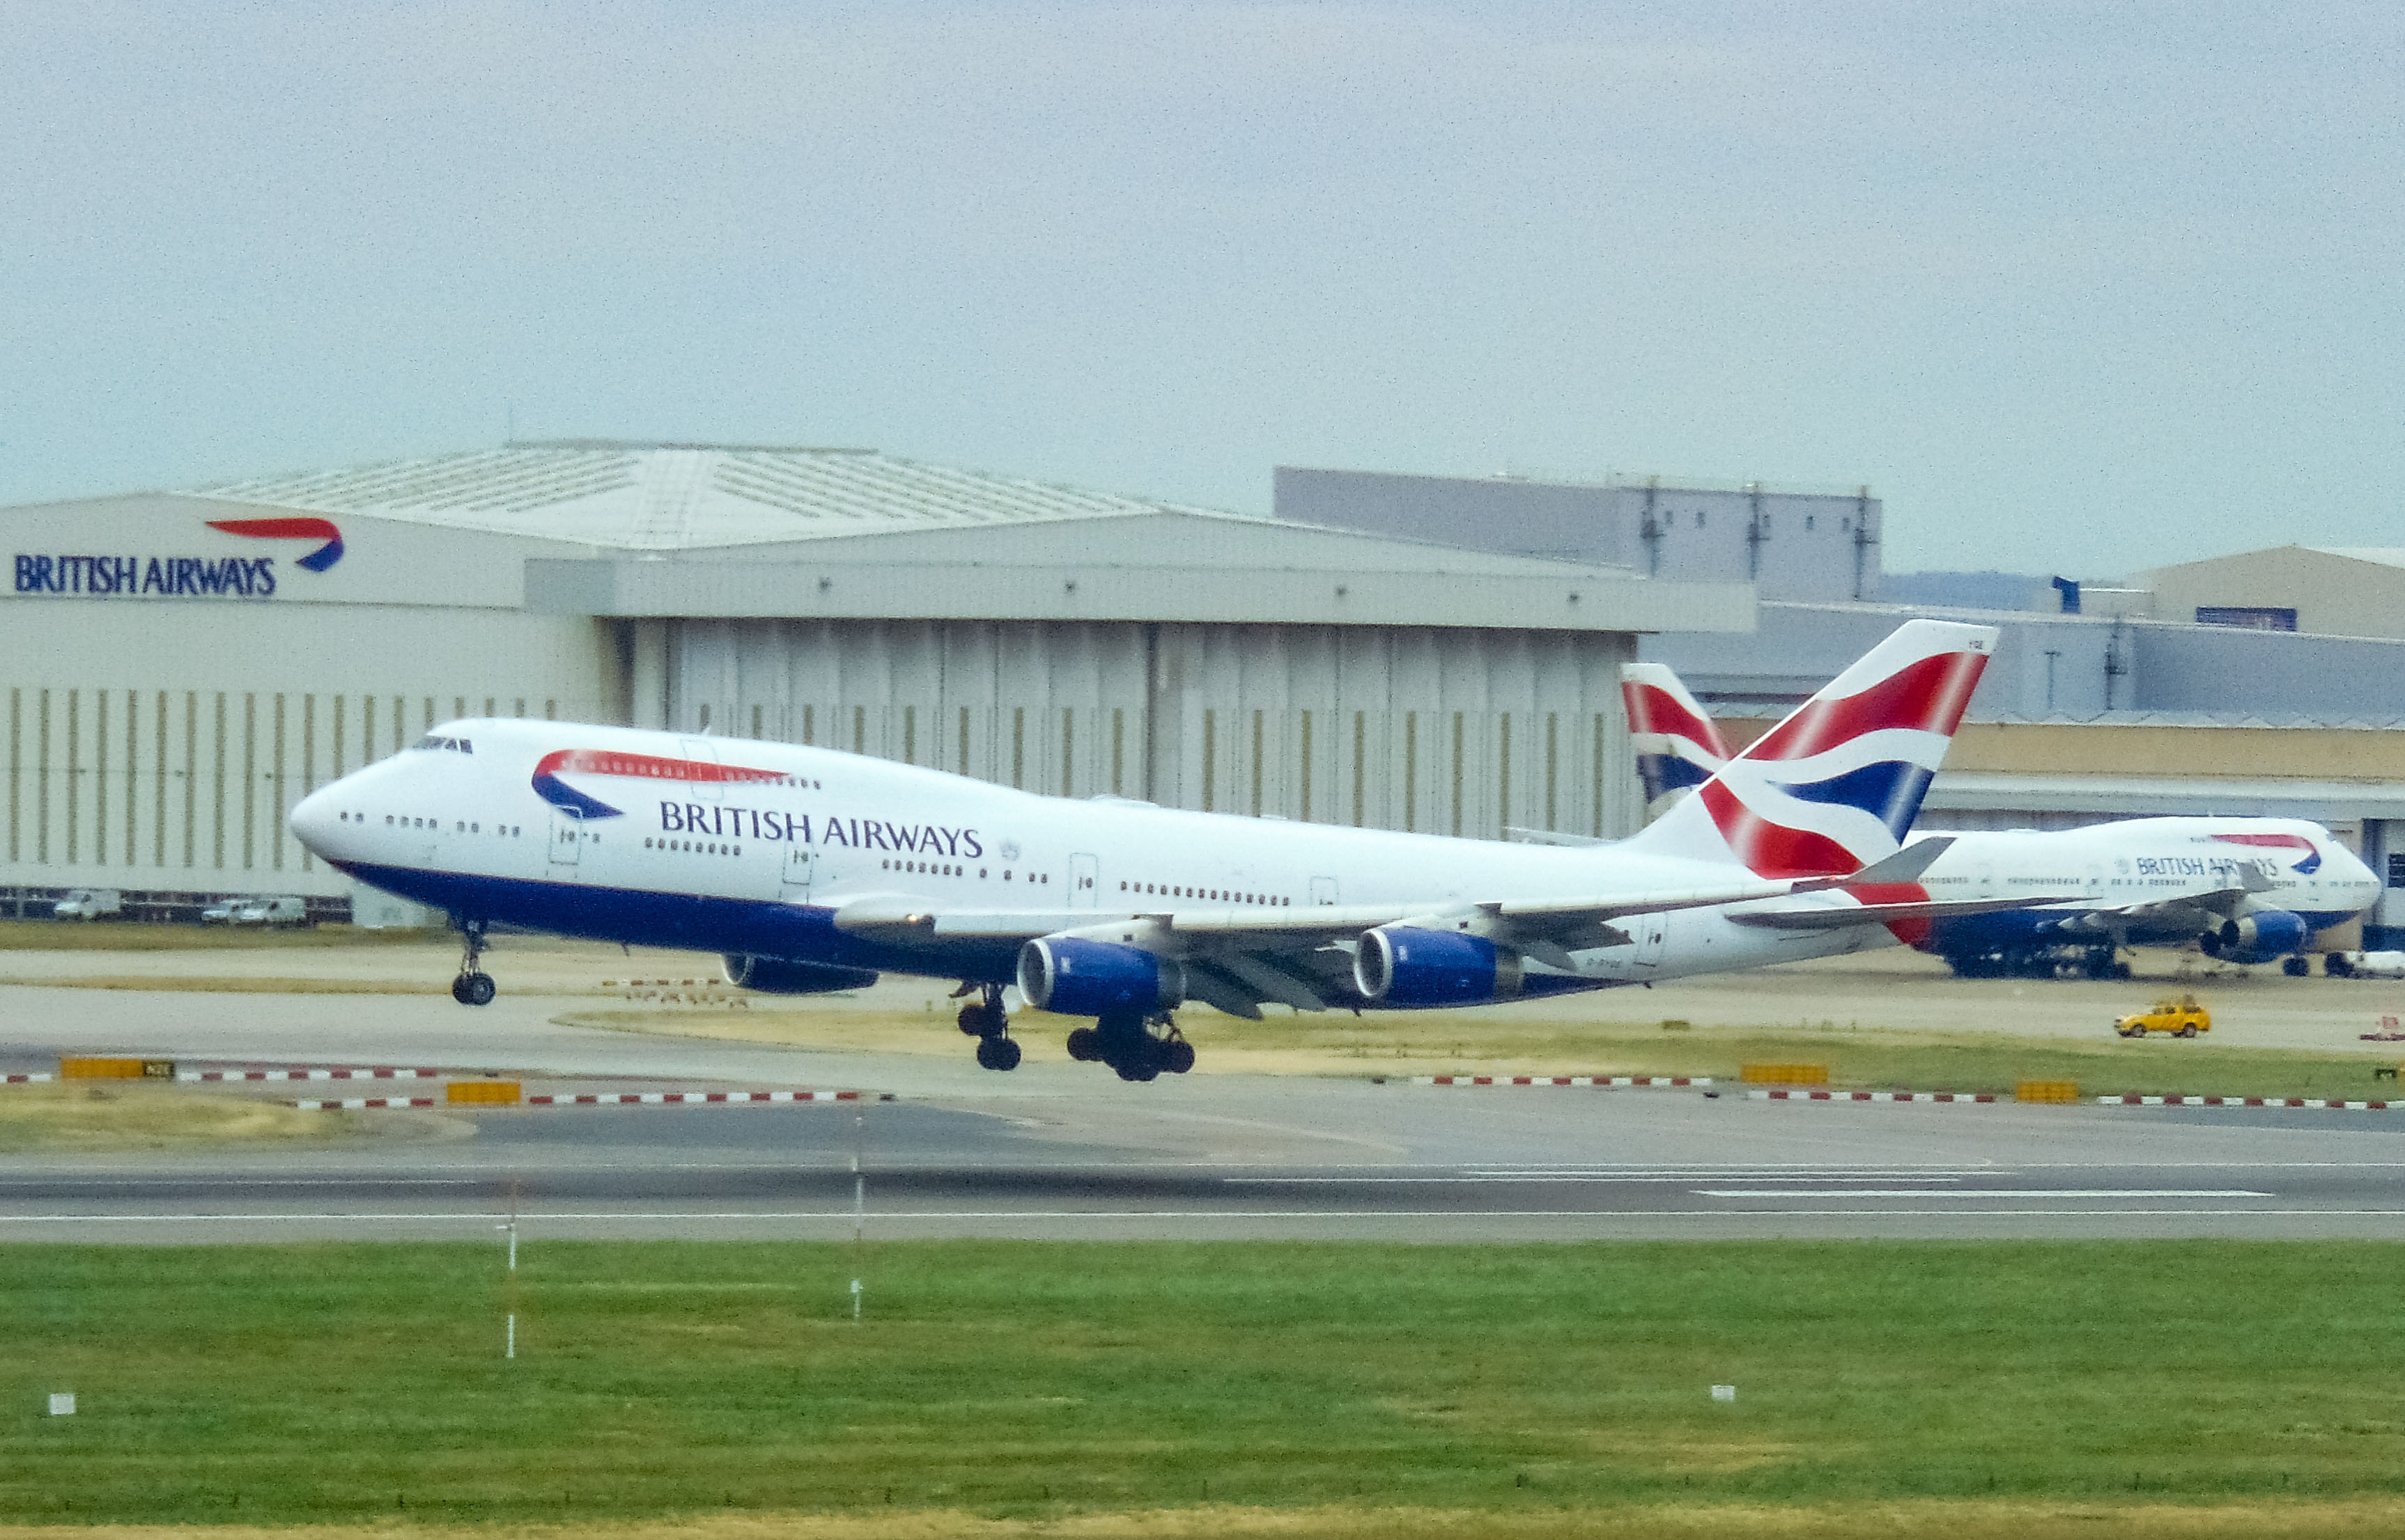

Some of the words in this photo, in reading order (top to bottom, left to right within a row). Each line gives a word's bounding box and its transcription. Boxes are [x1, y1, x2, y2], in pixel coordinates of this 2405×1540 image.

[15, 555, 138, 593] BRITISH
[142, 557, 277, 596] AIRWAYS
[660, 801, 812, 843] BRITISH
[823, 817, 983, 859] AIRWAYS
[2137, 857, 2205, 876] BRITISH
[2209, 857, 2278, 876] AIRYS
